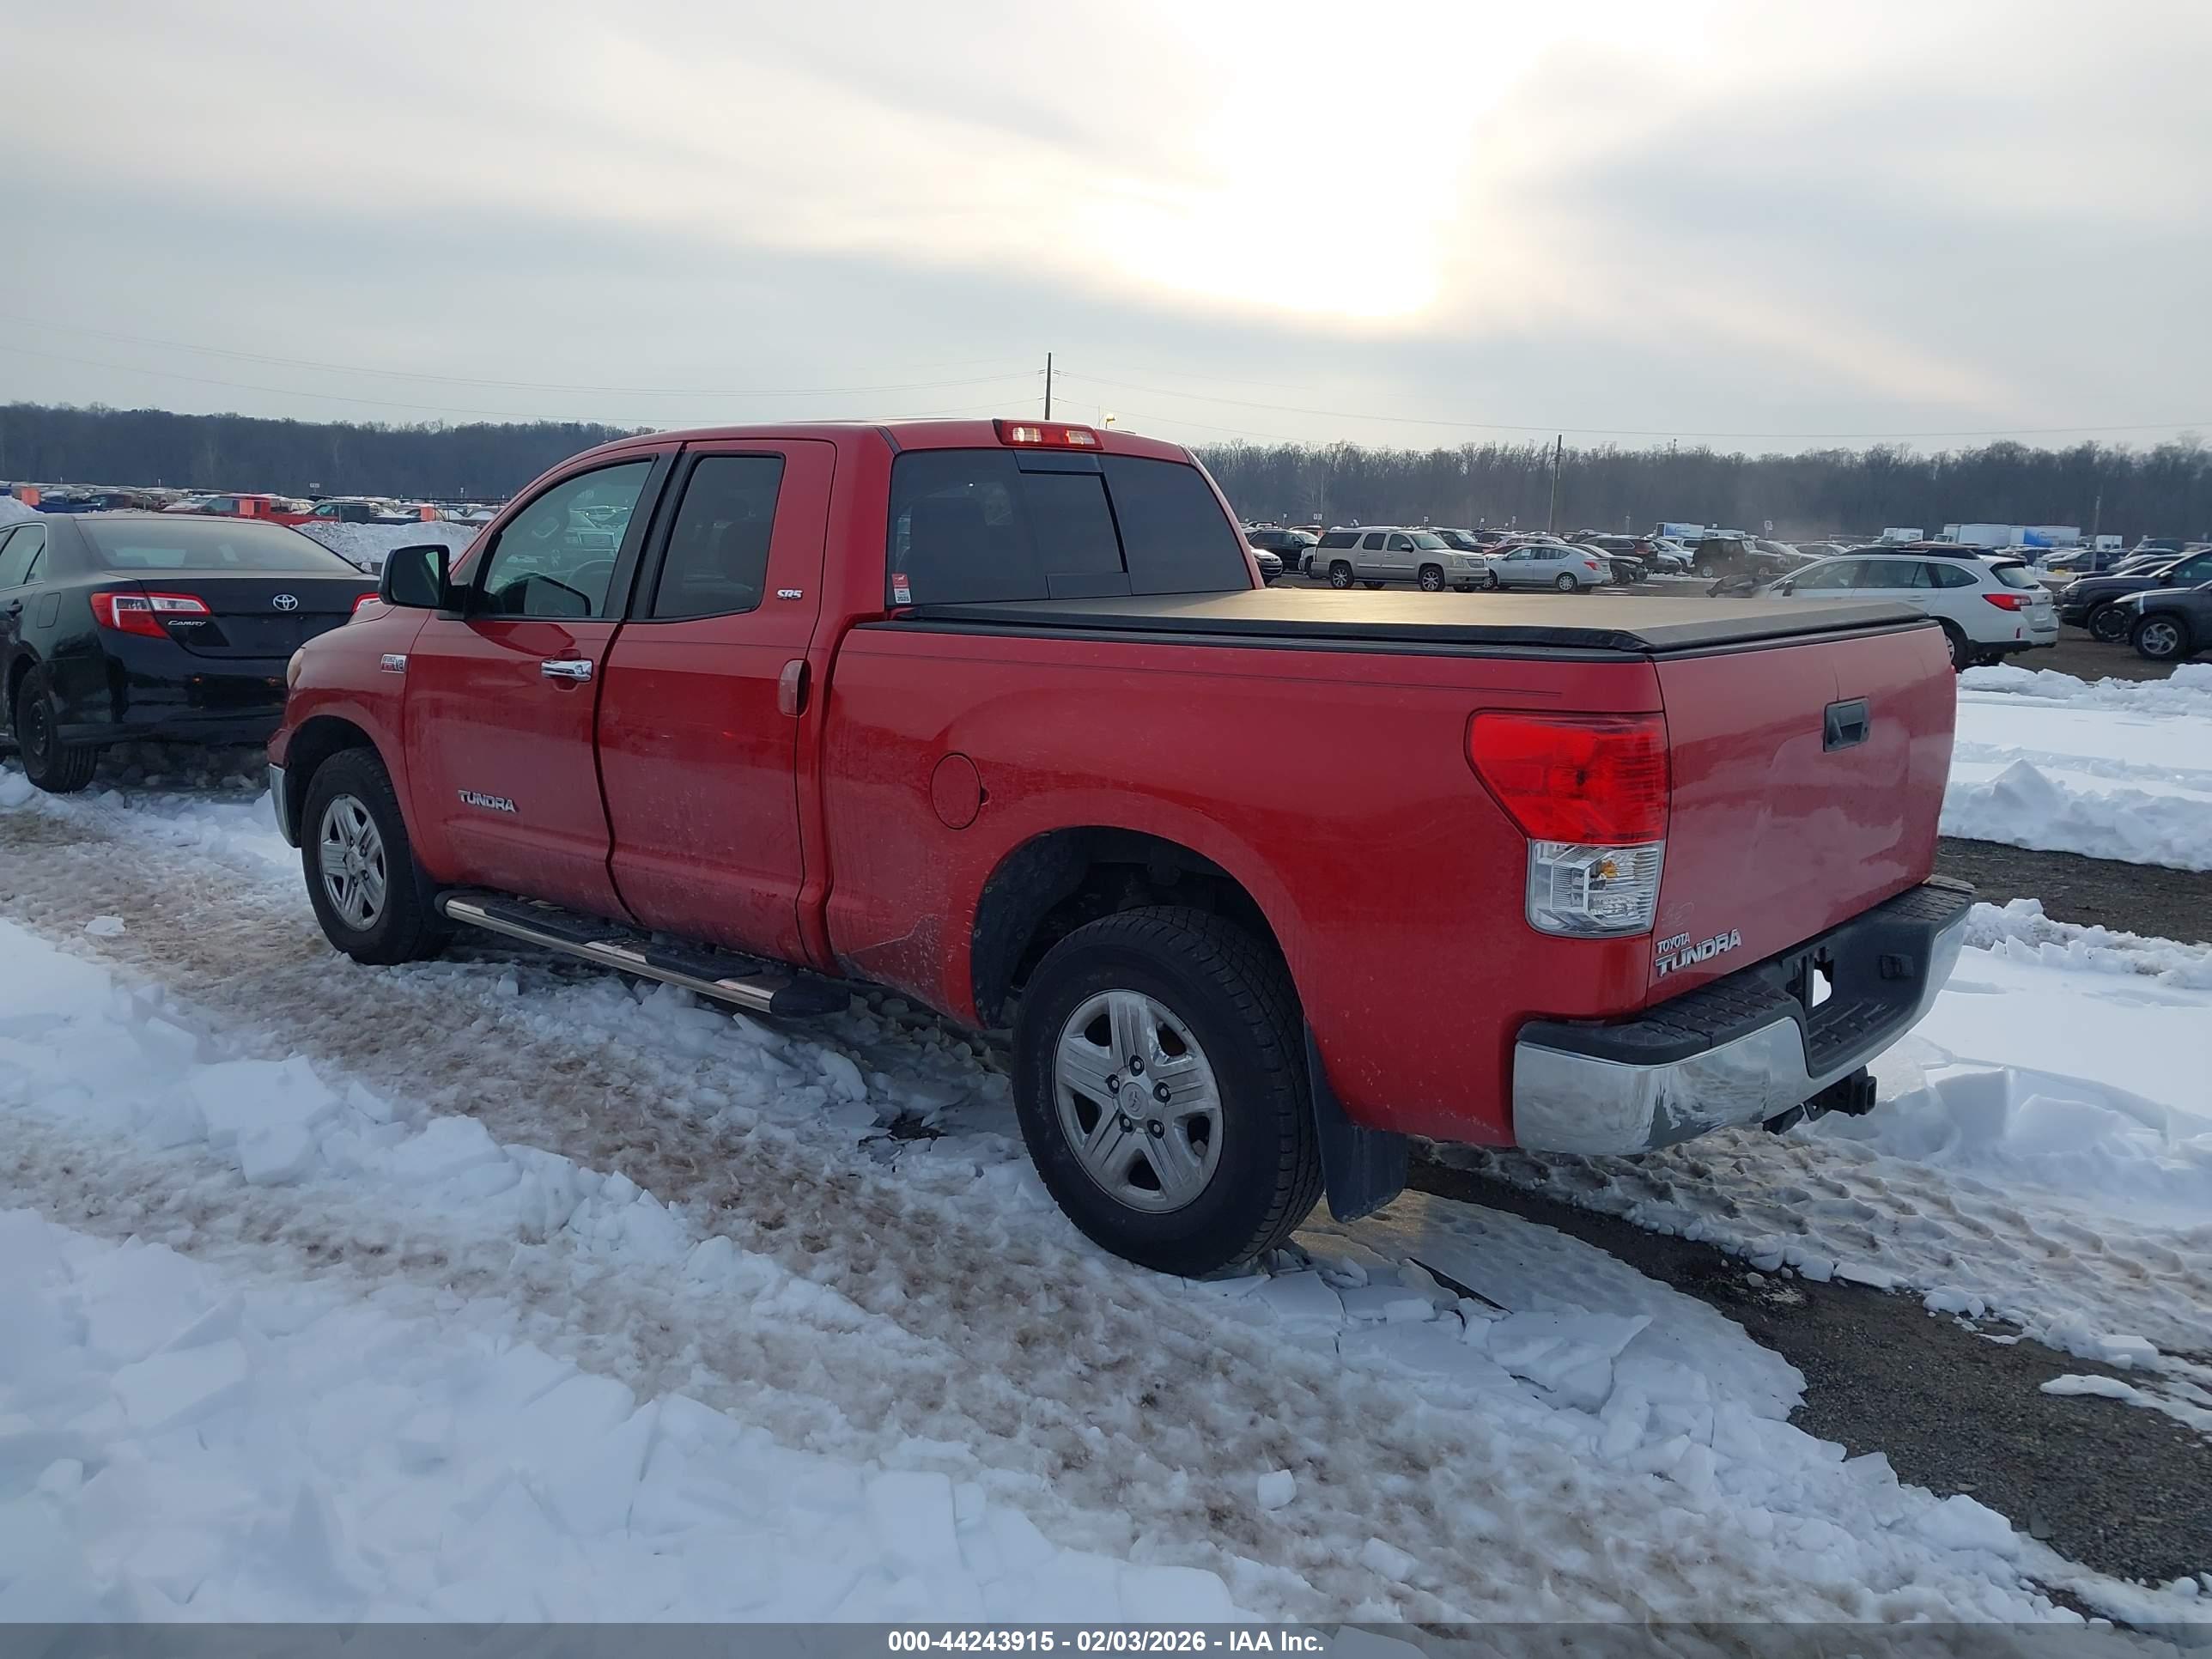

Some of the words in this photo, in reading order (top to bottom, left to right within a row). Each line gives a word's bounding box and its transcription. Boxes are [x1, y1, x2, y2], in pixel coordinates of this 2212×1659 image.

[777, 589, 803, 599] SR5
[458, 789, 516, 813] TUNDRA
[1655, 927, 1742, 977] TUNDRA
[1656, 932, 1691, 954] TOYOTA
